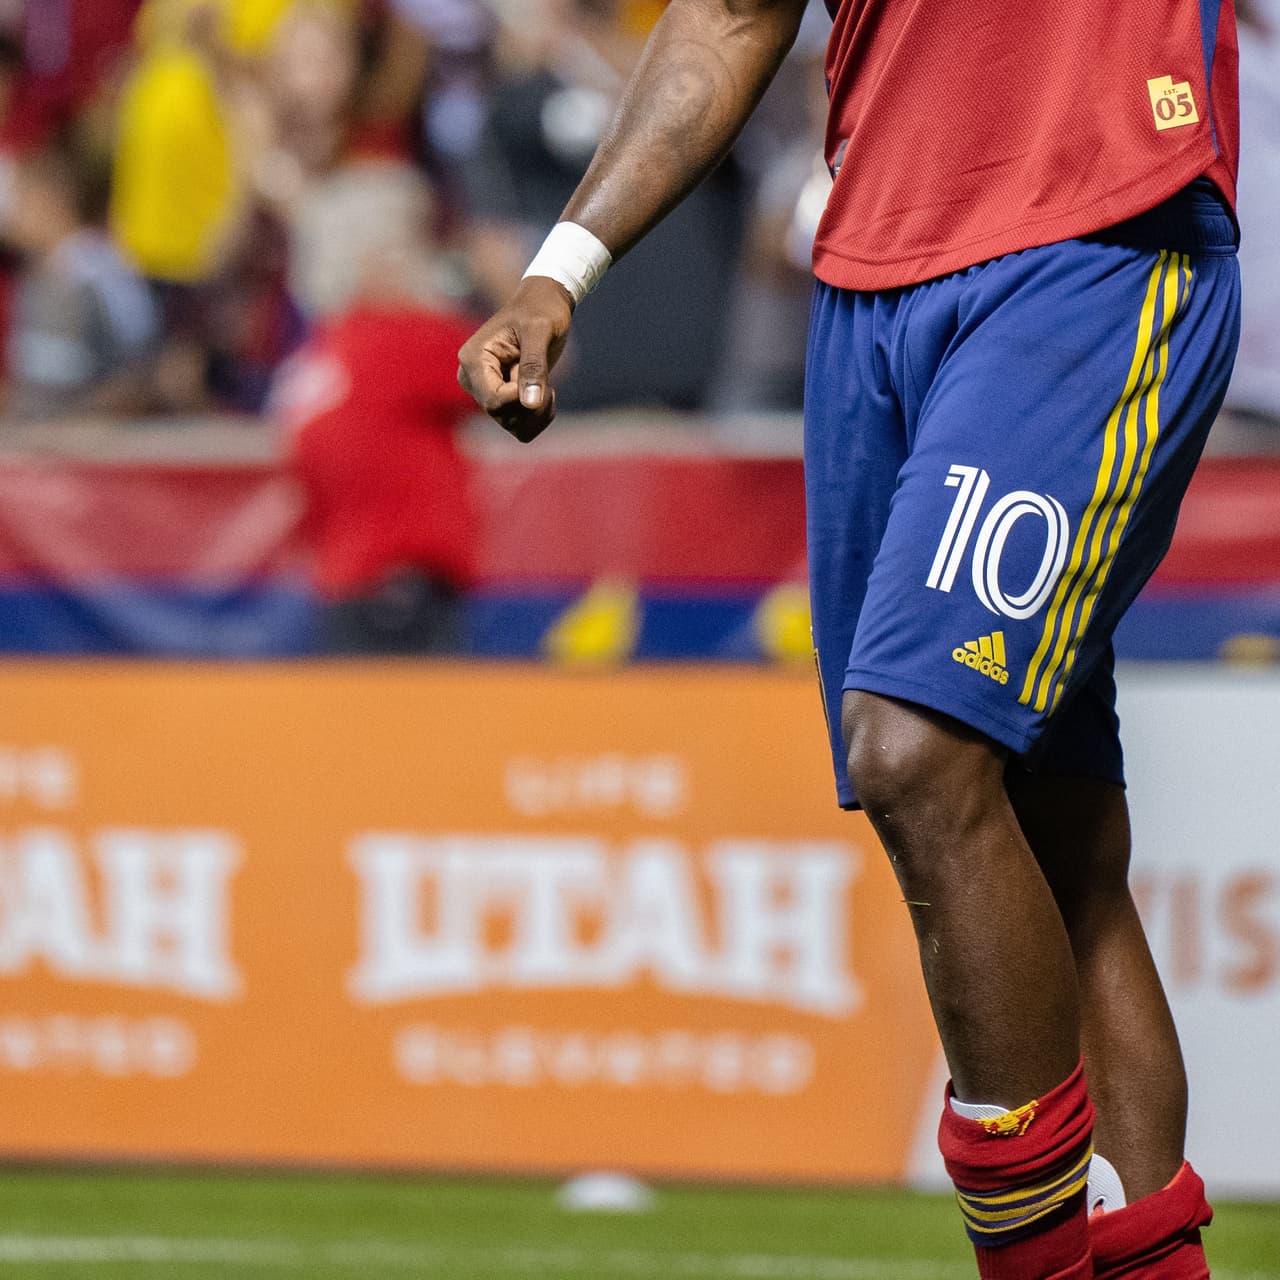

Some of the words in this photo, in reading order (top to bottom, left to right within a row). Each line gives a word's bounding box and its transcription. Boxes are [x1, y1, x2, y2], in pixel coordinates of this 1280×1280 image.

[1155, 92, 1193, 121] 05
[925, 464, 1070, 620] 10
[951, 647, 1010, 686] adidas
[346, 832, 863, 1017] UTAH
